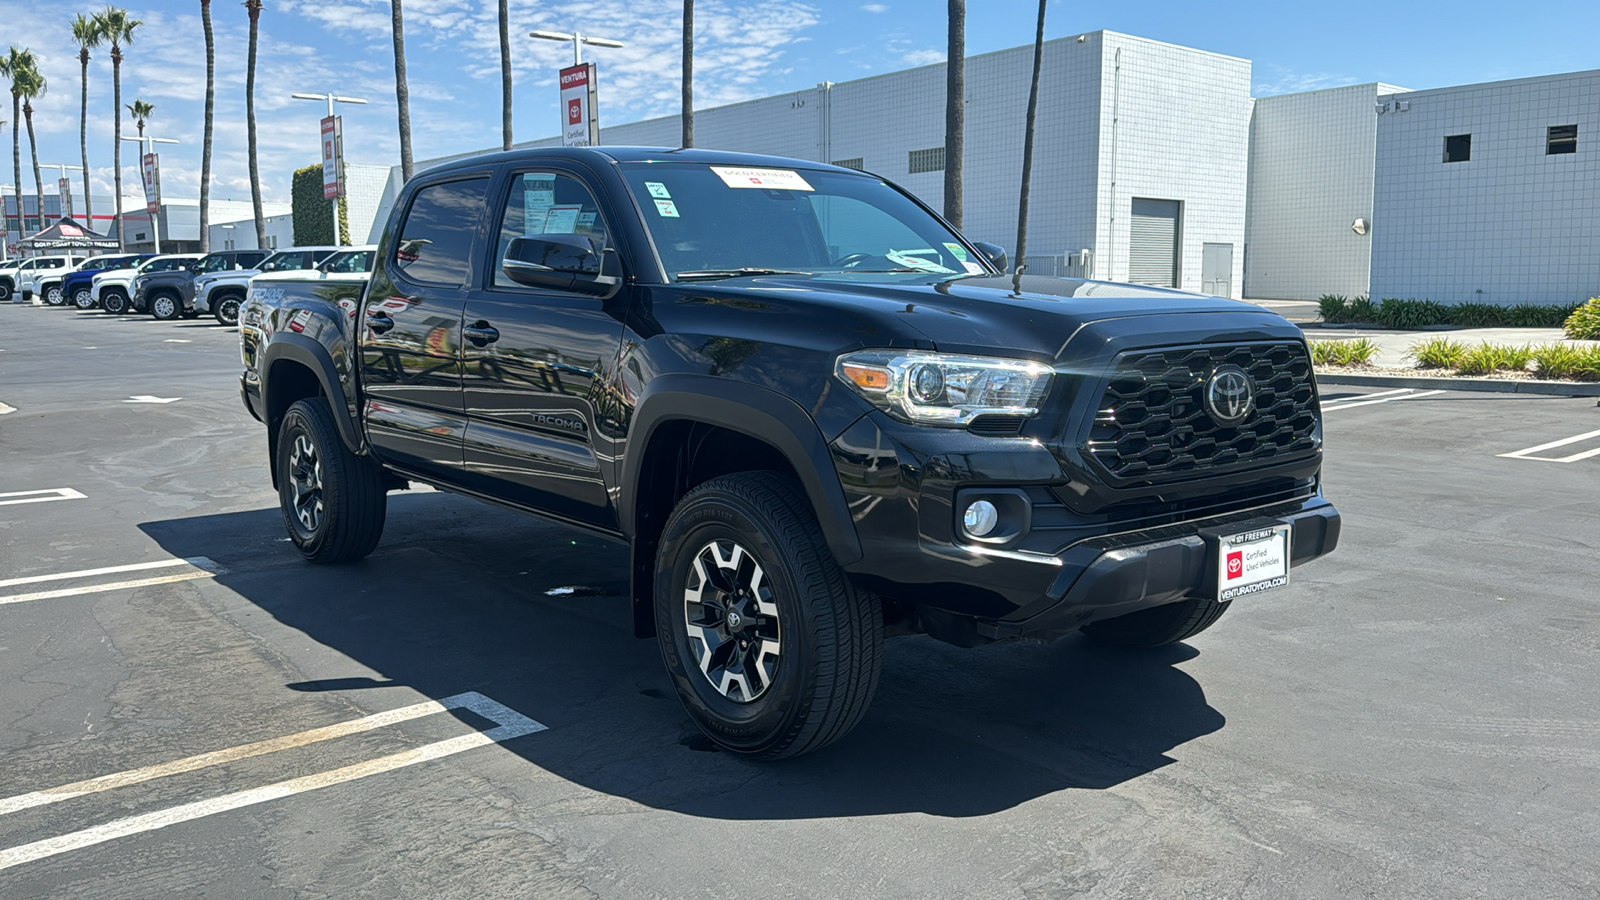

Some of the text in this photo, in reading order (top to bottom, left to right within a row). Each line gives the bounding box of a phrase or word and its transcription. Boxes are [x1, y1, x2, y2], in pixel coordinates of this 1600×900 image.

[561, 71, 587, 84] VENTURA
[530, 413, 583, 430] TACOMA
[1235, 529, 1273, 543] 101 FREEWAY
[1246, 548, 1267, 560] Certified
[1246, 557, 1279, 571] Used Vehicles
[1221, 577, 1287, 600] VENTURATOYOTA.COM
